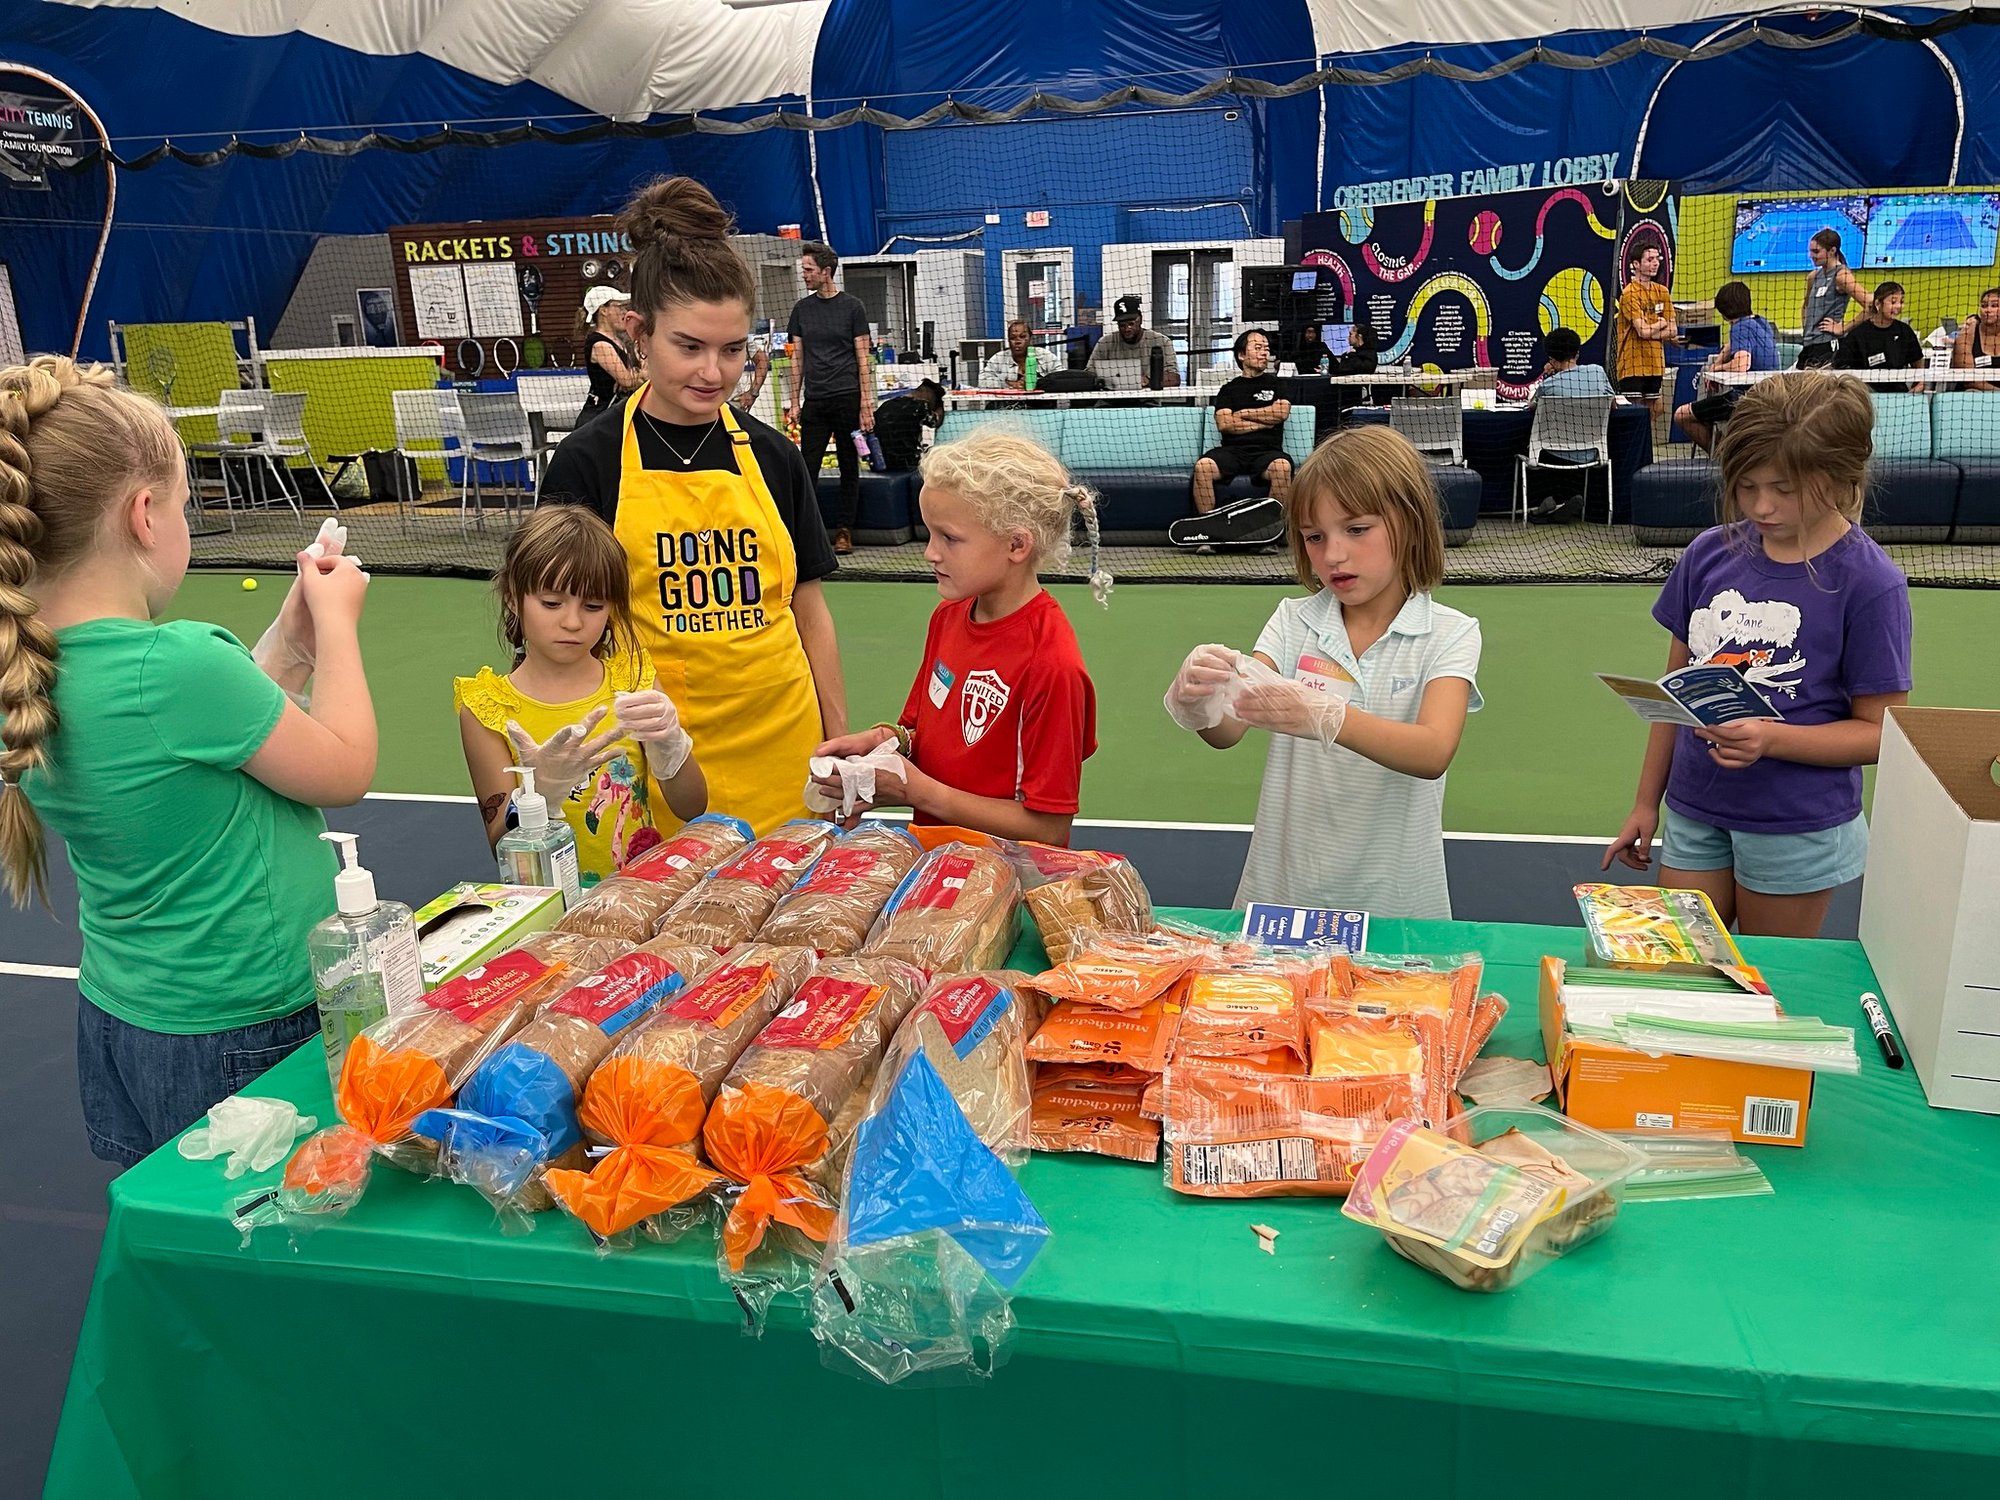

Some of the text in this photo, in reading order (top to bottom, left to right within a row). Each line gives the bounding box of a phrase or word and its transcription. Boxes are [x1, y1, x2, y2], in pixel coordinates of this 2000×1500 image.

[1460, 163, 1535, 195] FAMILY
[1542, 152, 1619, 187] LOBBY
[404, 236, 513, 262] RACKETS
[521, 235, 539, 257] &
[1372, 242, 1406, 268] CLOSING
[1317, 255, 1346, 277] HEALTH
[1379, 267, 1395, 280] THE
[658, 566, 762, 610] GOOD
[662, 609, 765, 633] TOGETHER
[1736, 612, 1763, 628] Jane
[1313, 659, 1343, 673] HELLO
[965, 683, 1004, 706] UNITED
[1313, 918, 1327, 936] Giving
[1330, 911, 1342, 936] Passport
[487, 969, 518, 988] Wheat
[504, 971, 530, 989] Bread
[831, 994, 850, 1013] Bread
[798, 1016, 821, 1038] Honey
[1117, 1022, 1150, 1033] Mild
[1049, 1096, 1110, 1111] Cheddar
